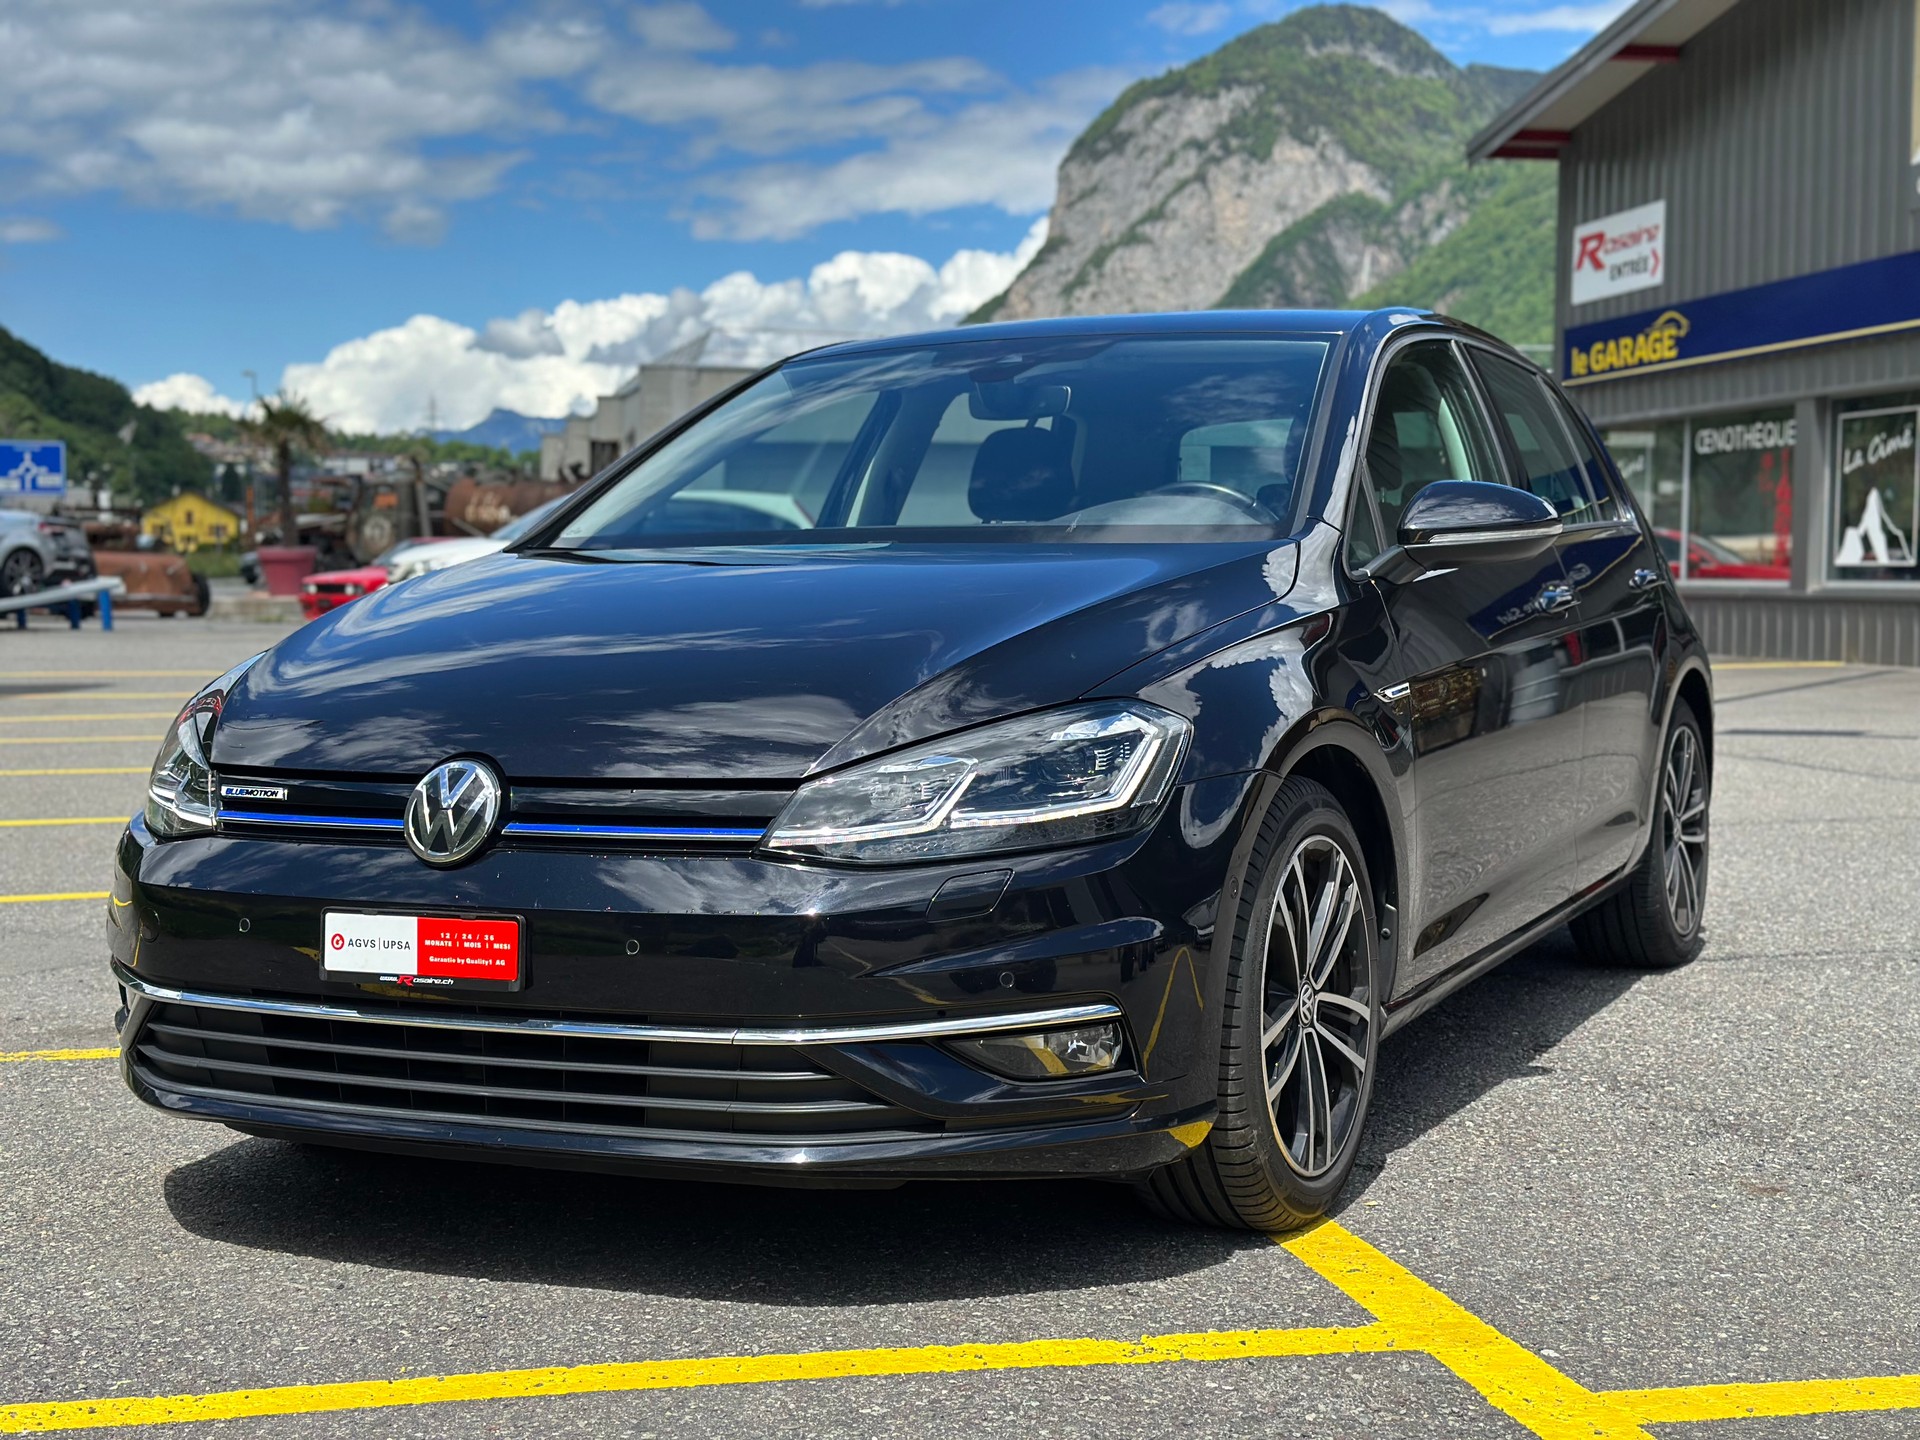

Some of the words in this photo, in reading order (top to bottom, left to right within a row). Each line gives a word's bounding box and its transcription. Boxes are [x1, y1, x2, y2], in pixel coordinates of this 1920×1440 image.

[1589, 326, 1679, 373] GARAGE
[226, 787, 280, 798] BLUEMOTION
[347, 938, 377, 949] AGVS
[383, 939, 411, 951] UPSA
[464, 941, 482, 949] MOIS
